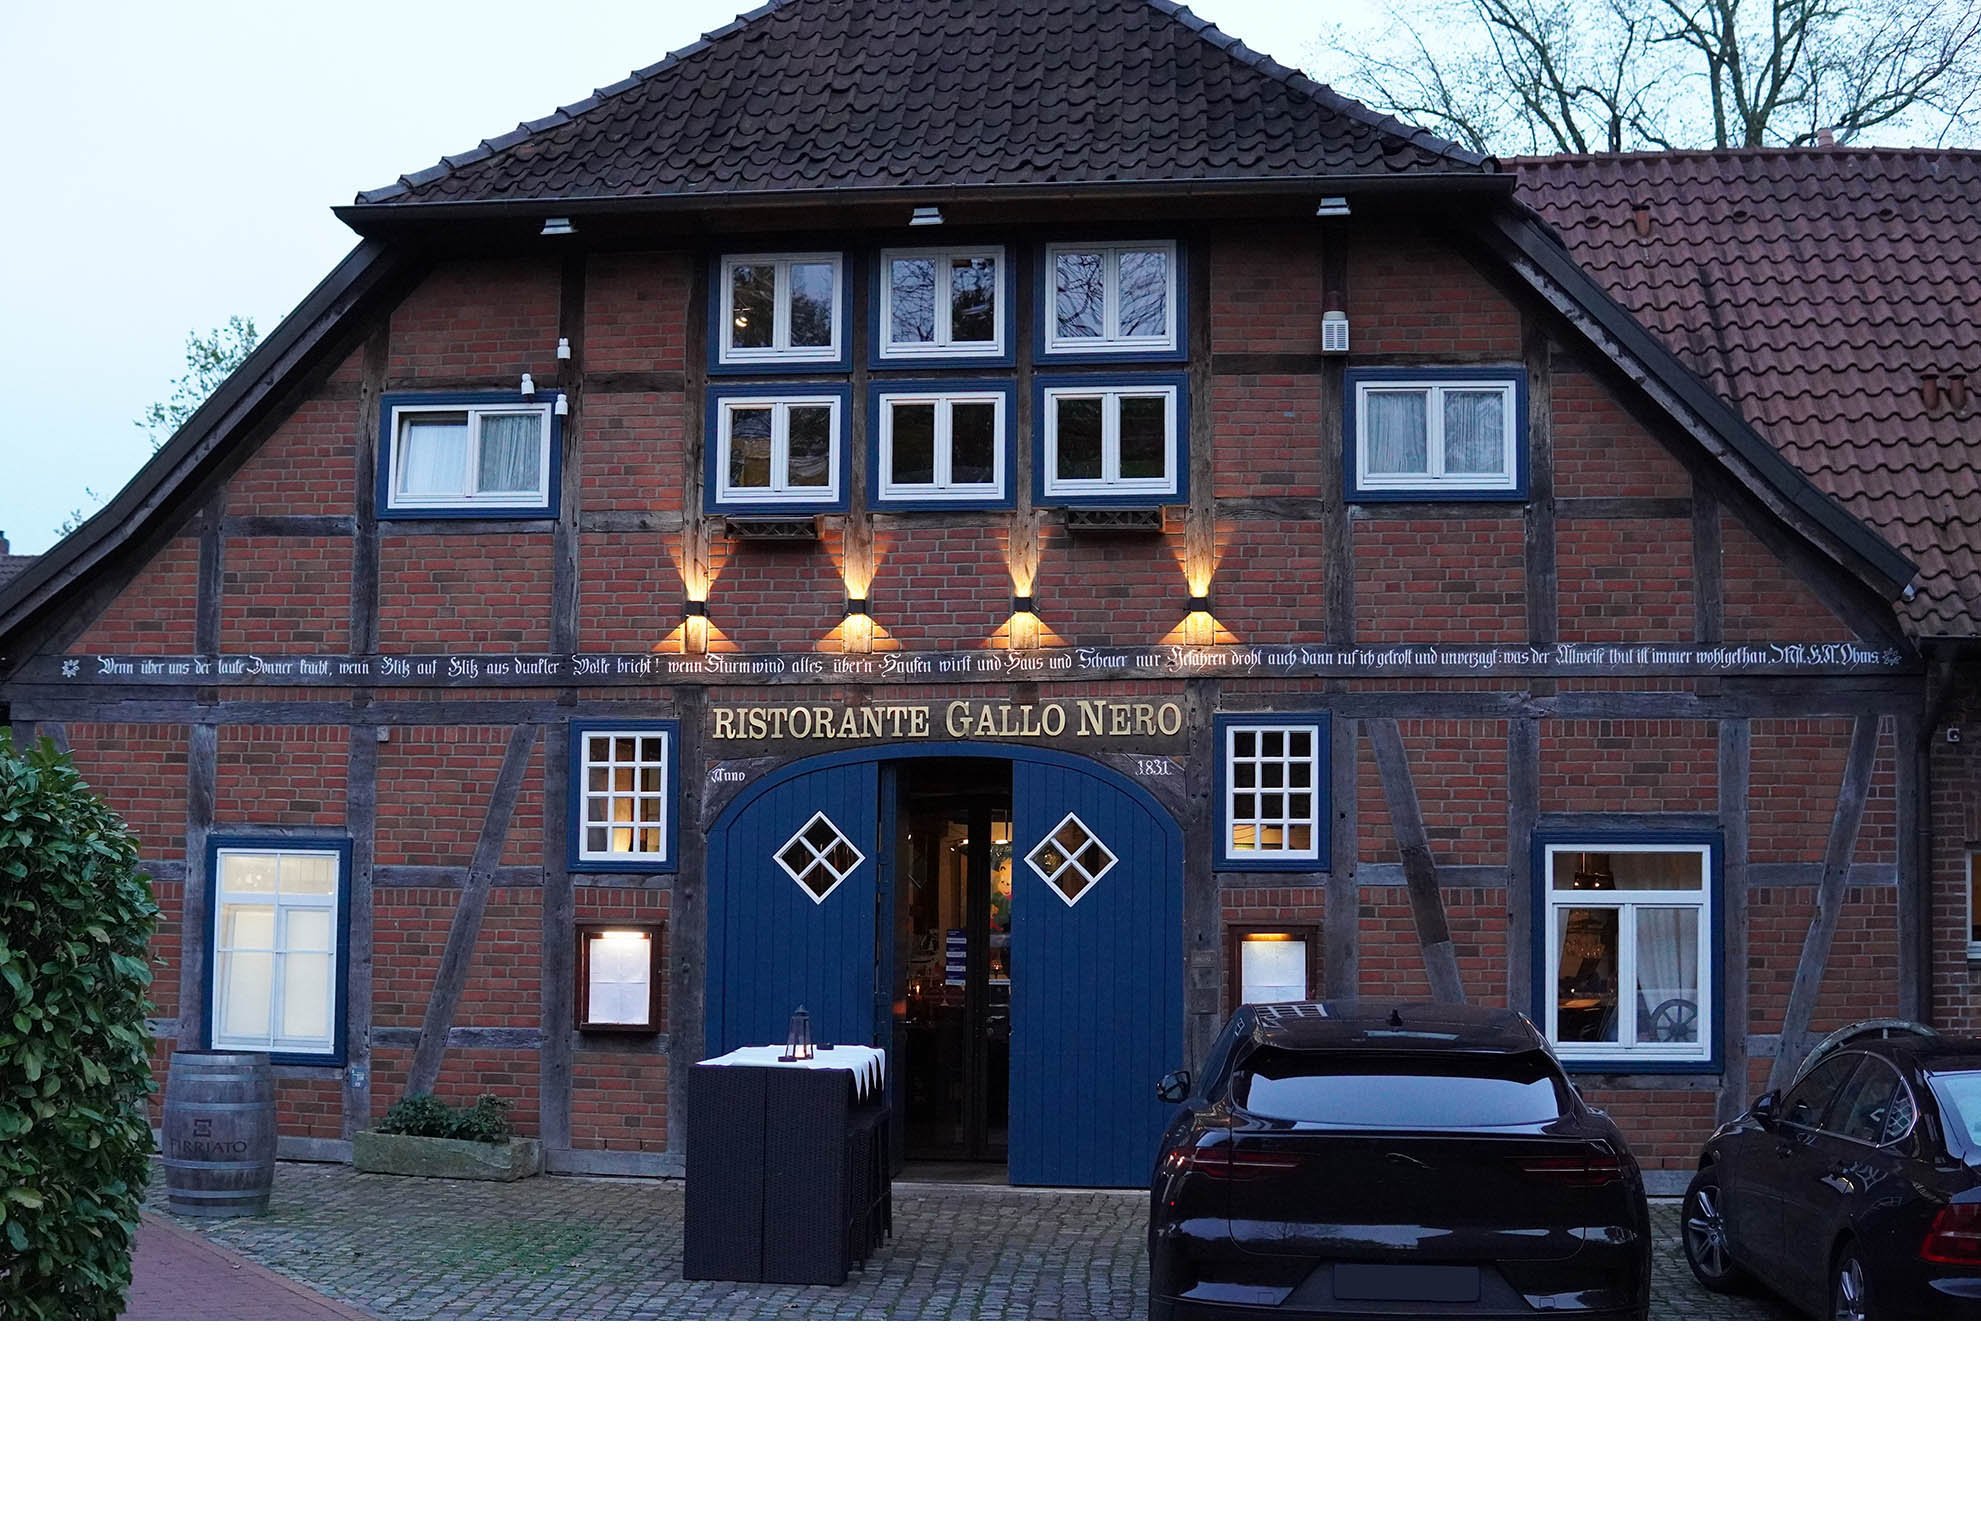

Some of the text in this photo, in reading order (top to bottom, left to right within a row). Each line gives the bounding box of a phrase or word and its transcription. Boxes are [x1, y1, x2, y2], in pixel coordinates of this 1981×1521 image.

[98, 656, 133, 675] Wenn
[141, 659, 165, 674] über
[169, 662, 189, 674] uns
[194, 658, 211, 674] der
[247, 655, 293, 675] Donner
[340, 661, 369, 674] wenn
[418, 659, 437, 678] auf
[486, 662, 509, 674] aus
[515, 657, 560, 674] dunkler
[668, 661, 702, 674] wenn
[792, 657, 823, 673] alles
[977, 655, 1001, 671] und
[1004, 652, 1043, 675] Haus
[1050, 654, 1072, 670] und
[1136, 653, 1161, 667] nur
[1231, 648, 1263, 674] droht
[1268, 649, 1297, 673] auch
[1301, 648, 1333, 665] dann
[1360, 649, 1375, 669] ich
[1415, 647, 1438, 665] und
[1504, 651, 1529, 665] was
[1530, 647, 1550, 665] der
[1652, 649, 1693, 665] immer
[712, 700, 1183, 740] RISTORANTE GALLO NERO
[711, 768, 746, 783] Anno
[1135, 759, 1173, 776] 1831
